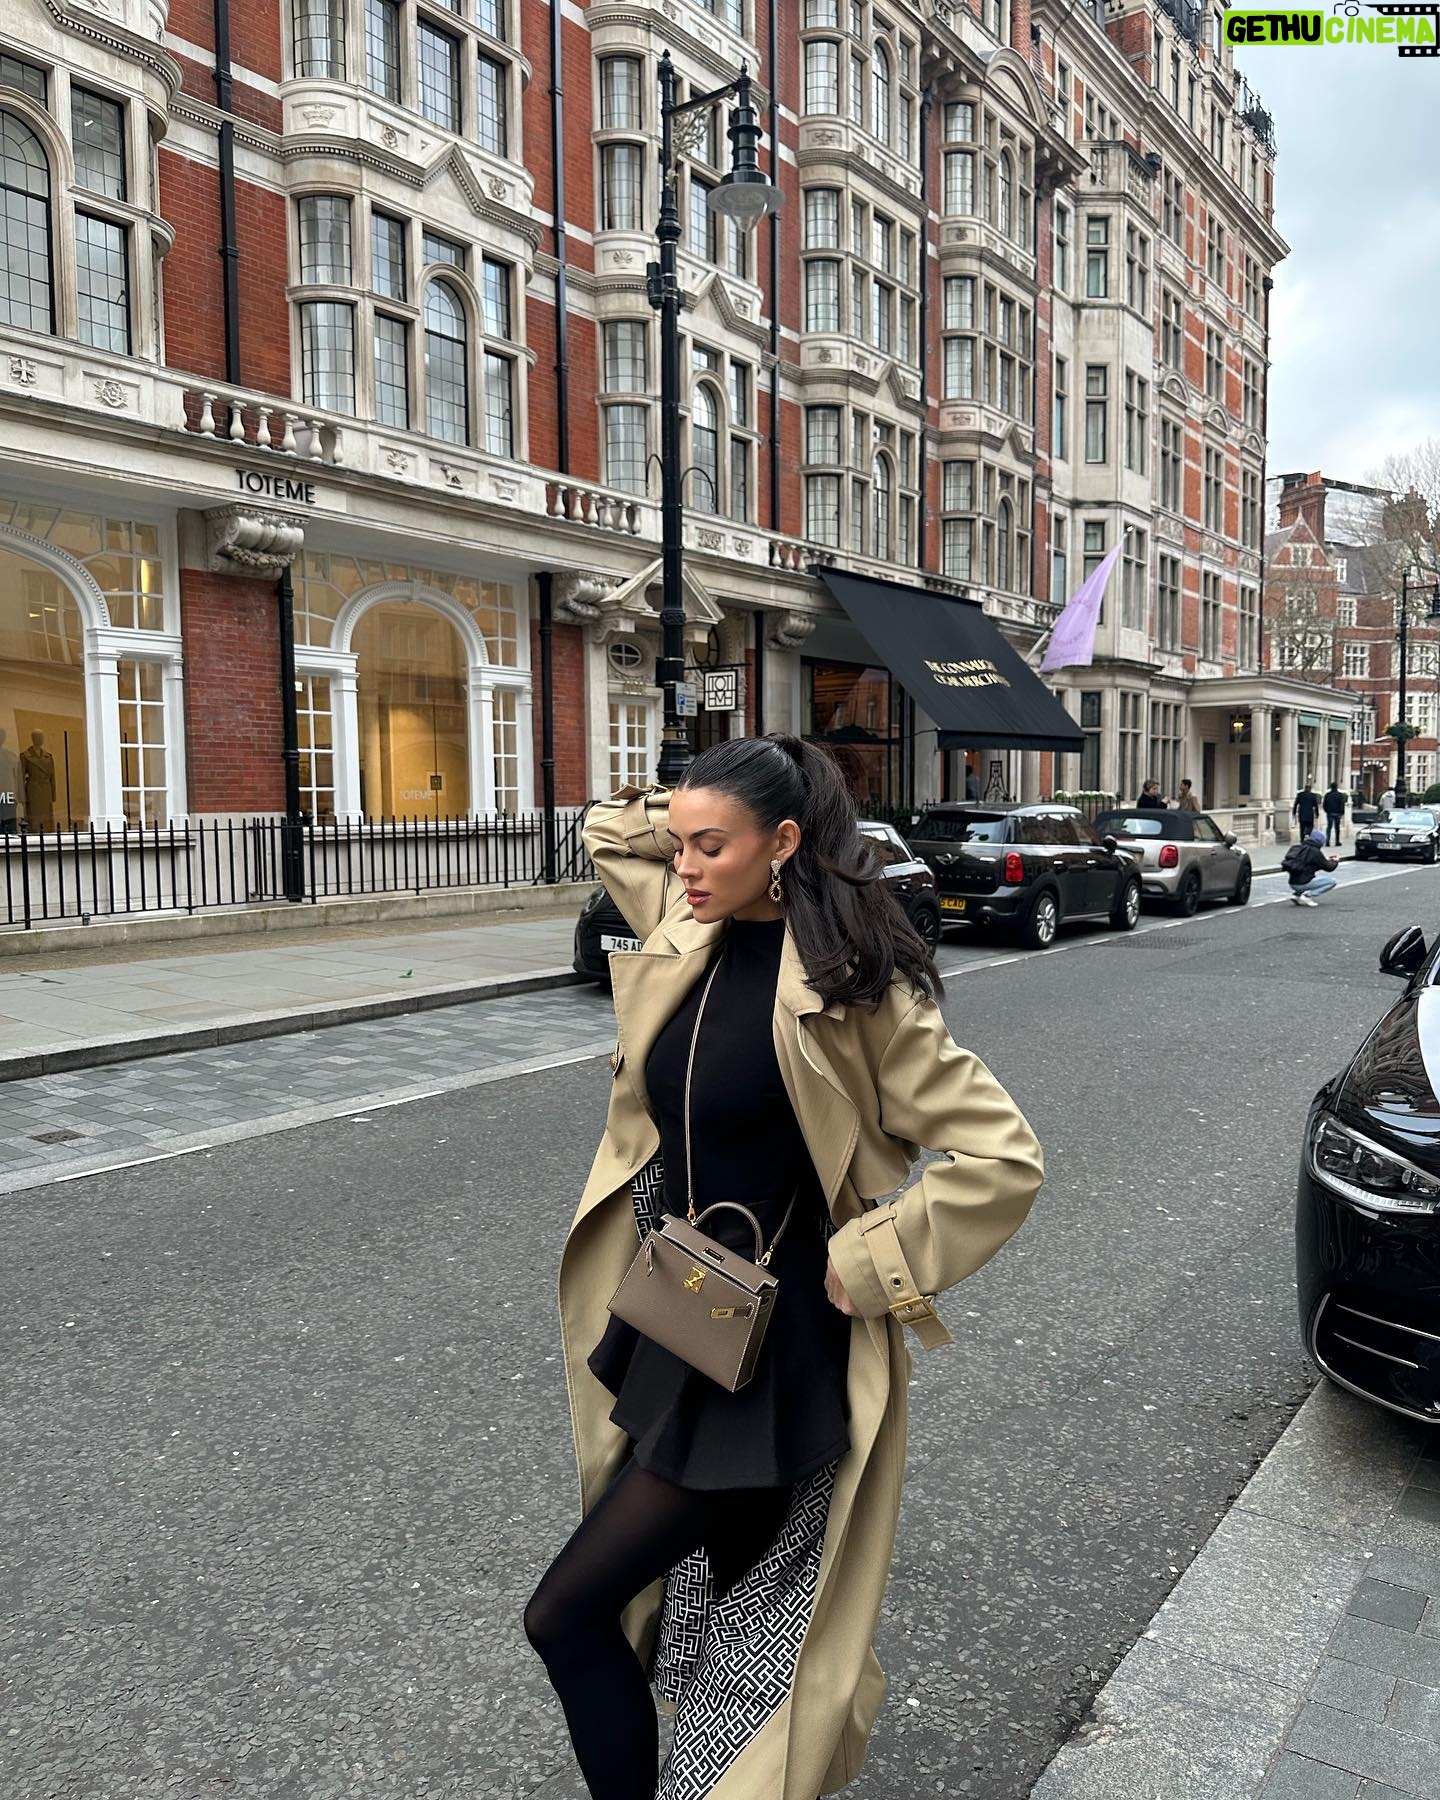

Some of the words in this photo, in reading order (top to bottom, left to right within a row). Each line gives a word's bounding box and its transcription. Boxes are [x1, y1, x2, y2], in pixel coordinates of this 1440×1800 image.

[235, 469, 316, 504] TOTEME
[959, 672, 1011, 687] MERCH
[400, 790, 434, 800] TOTEME
[611, 937, 629, 951] 745
